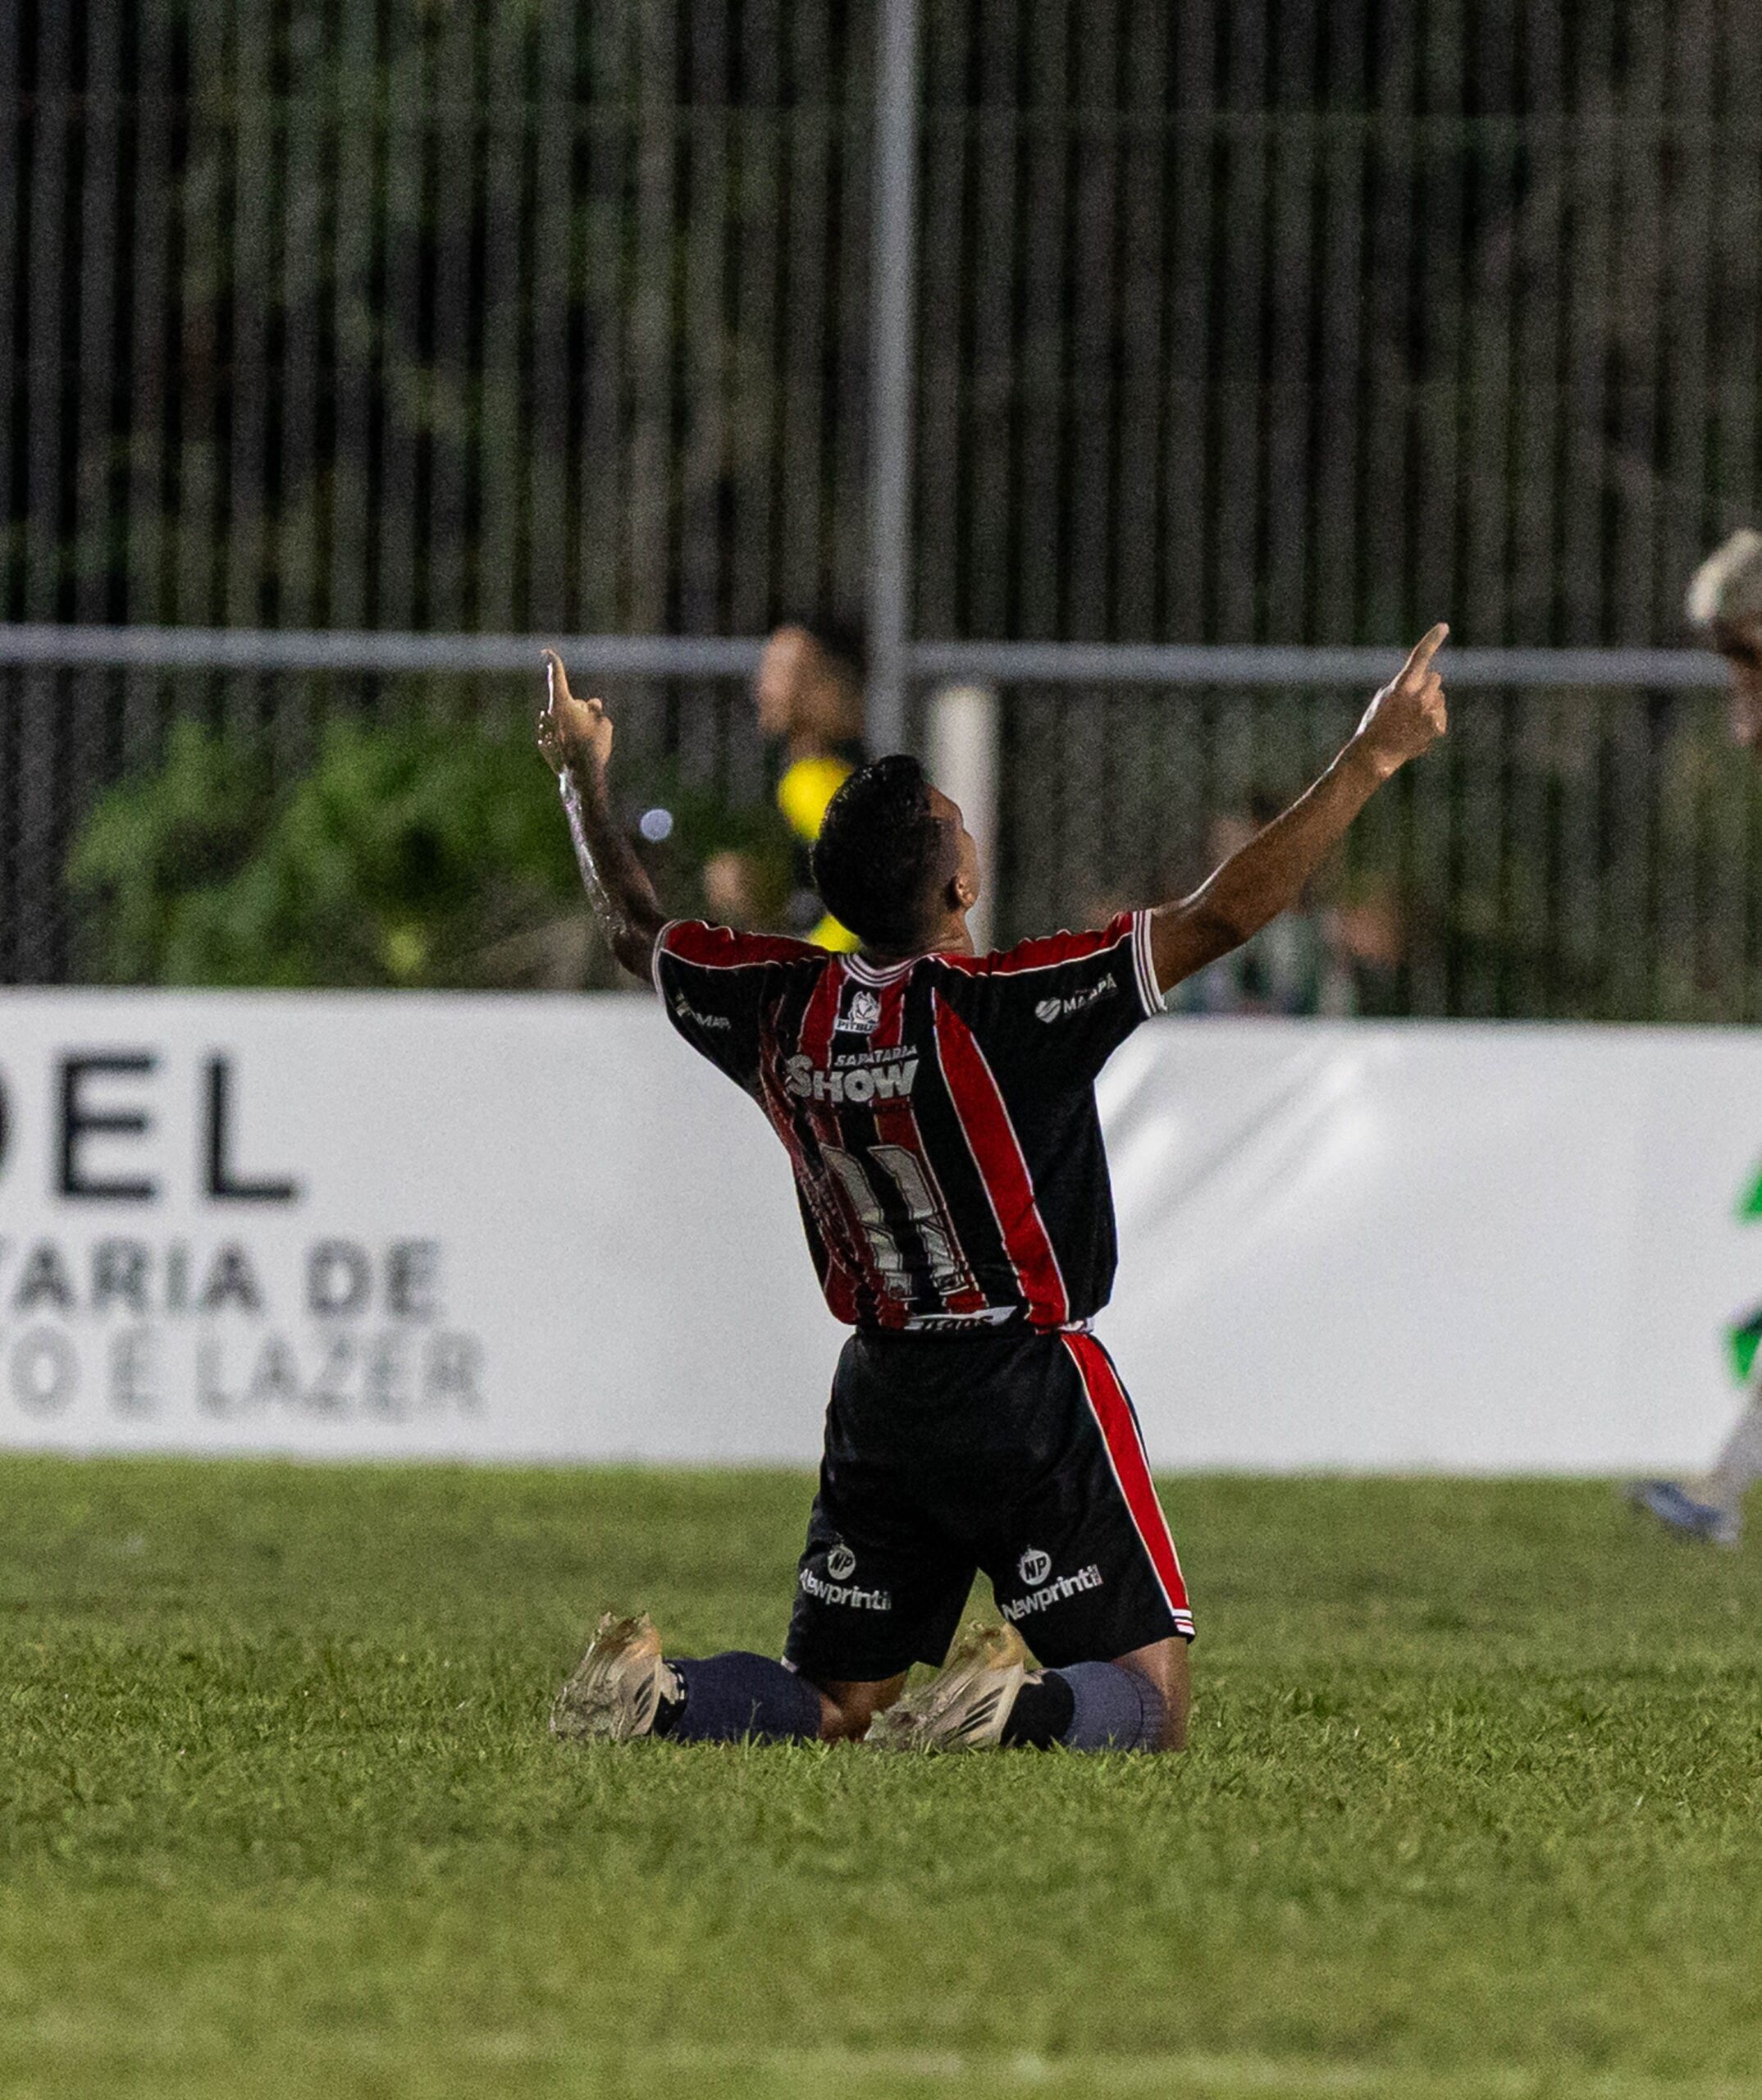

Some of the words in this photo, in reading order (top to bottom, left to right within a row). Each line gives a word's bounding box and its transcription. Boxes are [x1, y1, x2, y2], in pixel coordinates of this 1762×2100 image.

[785, 1054, 920, 1102] SHOW
[0, 1052, 299, 1204] EL
[0, 1237, 264, 1315] ARIA
[302, 1237, 441, 1317] DE
[195, 1324, 486, 1421] LAZER
